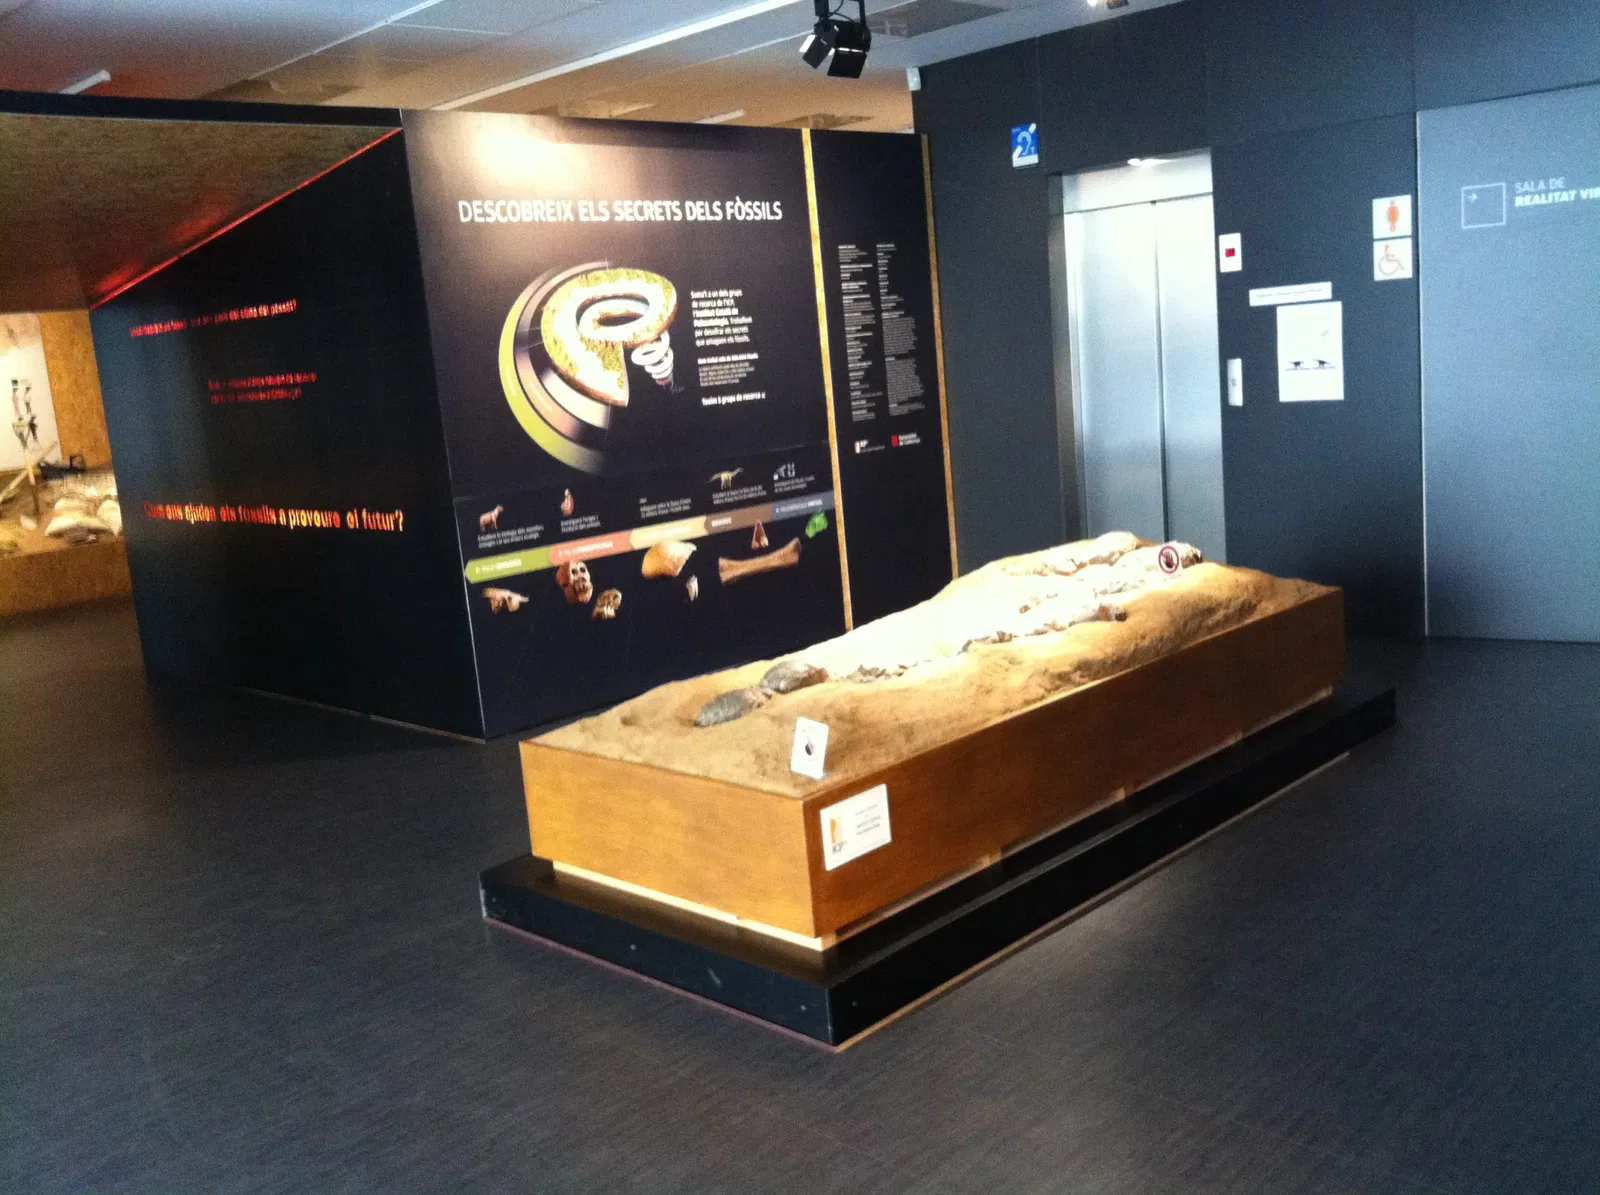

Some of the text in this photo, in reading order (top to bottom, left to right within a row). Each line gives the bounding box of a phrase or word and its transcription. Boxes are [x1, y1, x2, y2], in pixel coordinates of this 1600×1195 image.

[1515, 176, 1565, 193] SALA DE
[1515, 190, 1576, 206] REALITAT
[458, 196, 783, 223] DESCOBREIX ELS SECRETS DELS FÒSSILS
[279, 510, 287, 525] a
[362, 508, 403, 532] futur?
